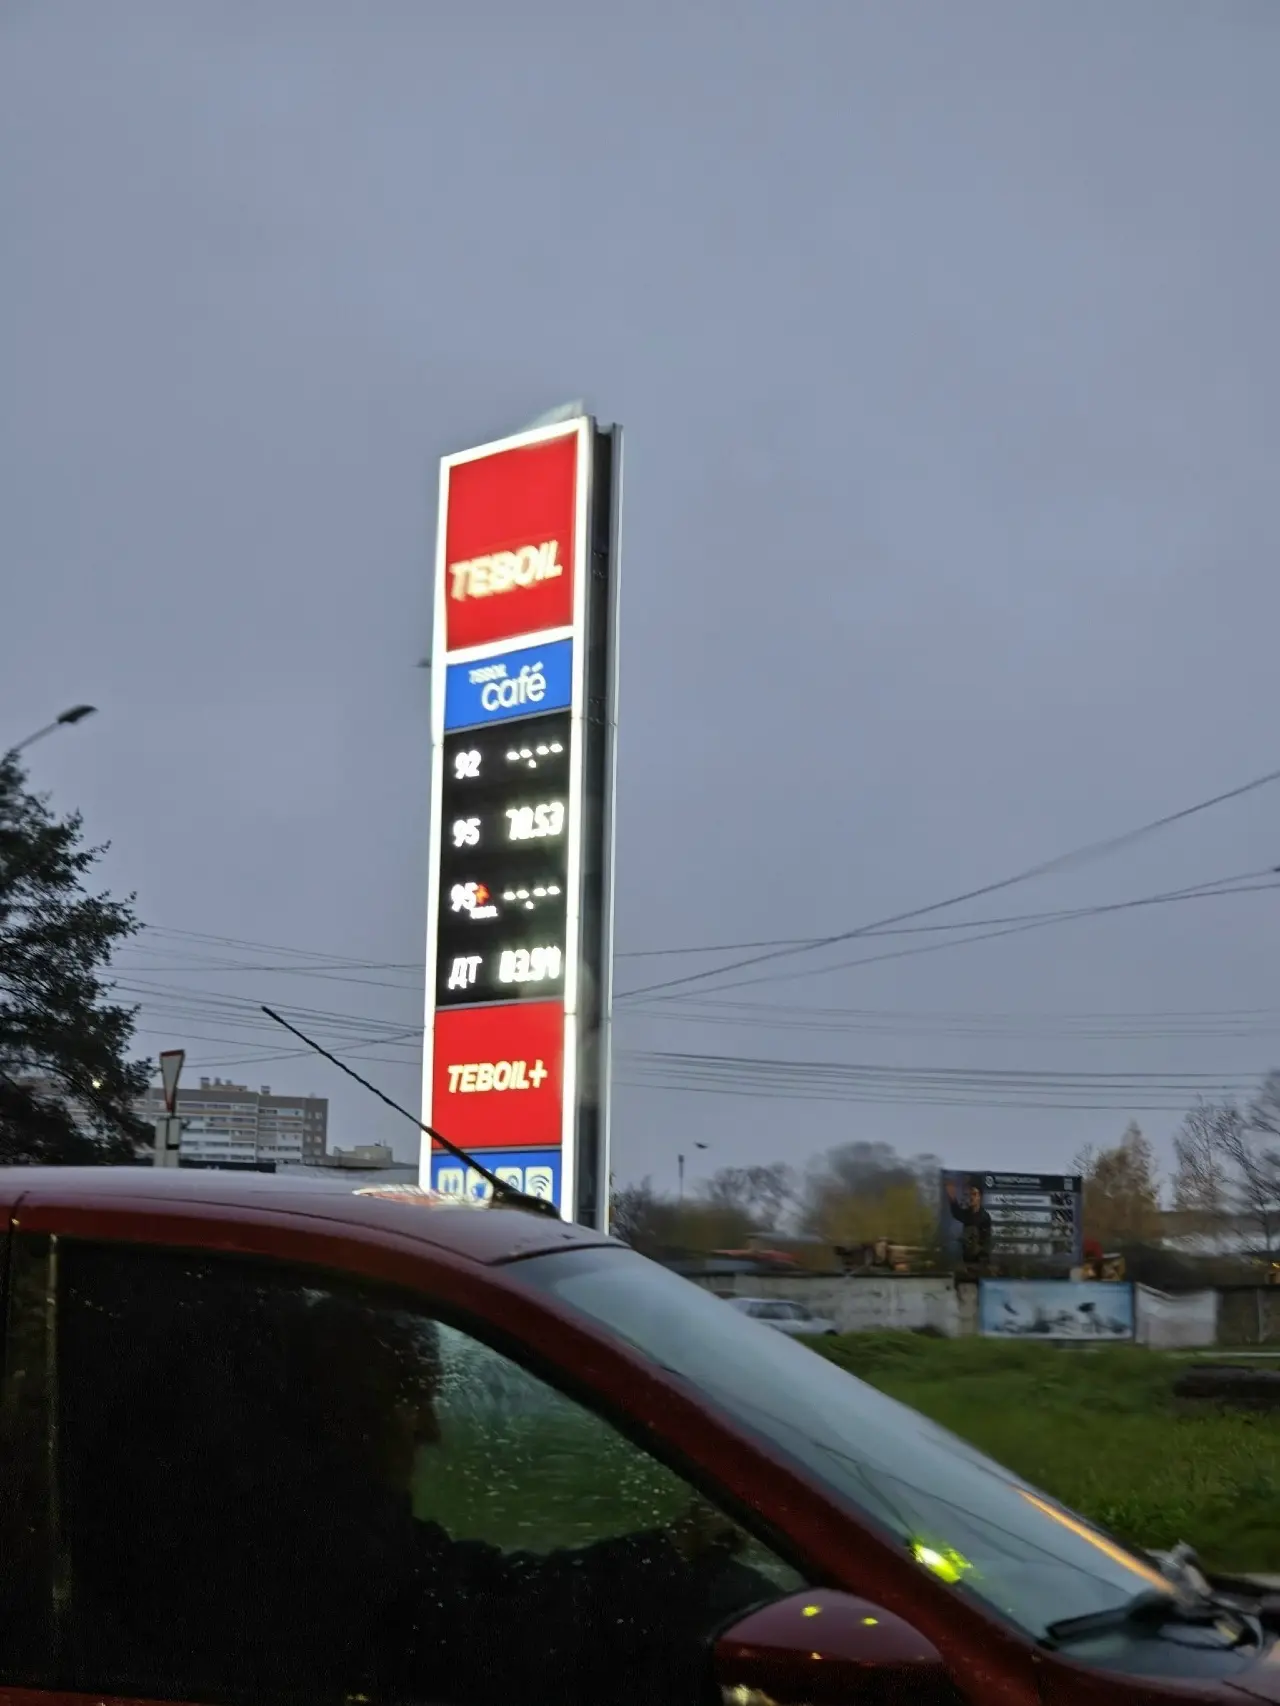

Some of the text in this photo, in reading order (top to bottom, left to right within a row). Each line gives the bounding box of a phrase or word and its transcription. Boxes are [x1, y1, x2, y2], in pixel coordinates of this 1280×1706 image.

[450, 540, 563, 601] TEBOIL
[482, 661, 546, 711] café
[455, 750, 481, 779] 92
[453, 818, 481, 847] 95
[448, 956, 482, 989] ДТ
